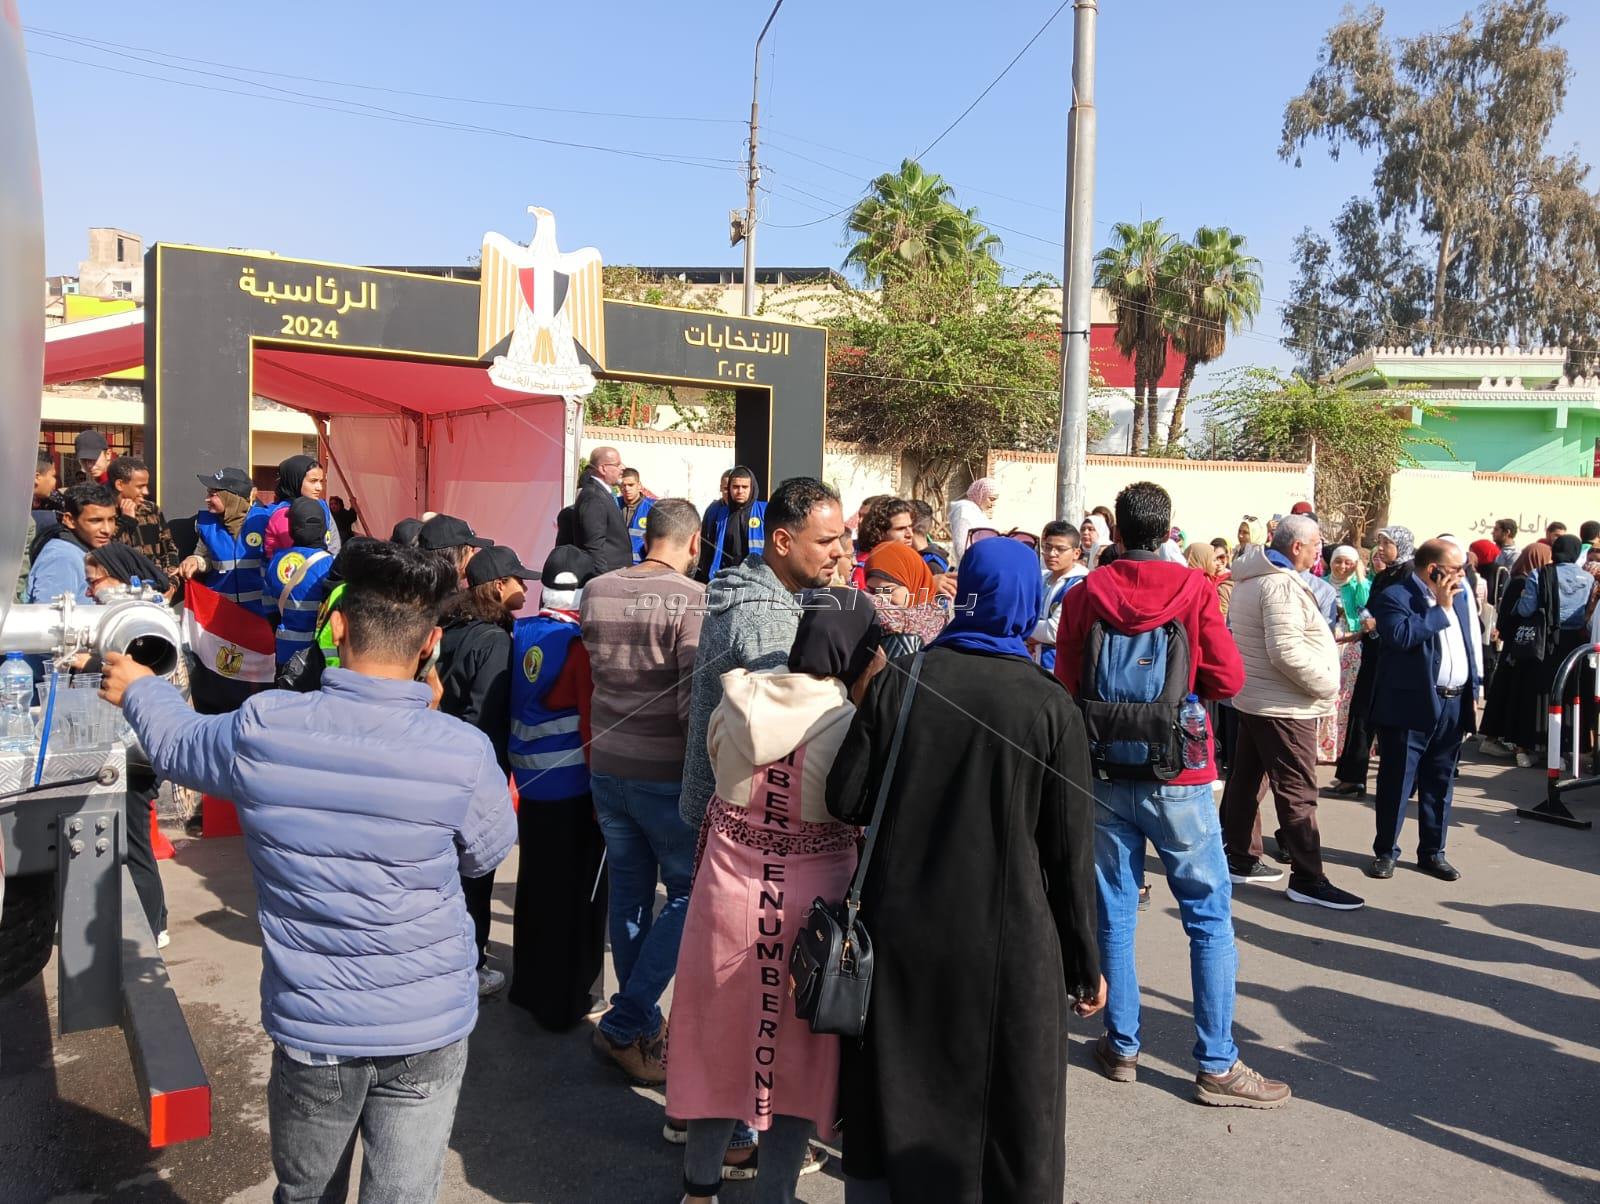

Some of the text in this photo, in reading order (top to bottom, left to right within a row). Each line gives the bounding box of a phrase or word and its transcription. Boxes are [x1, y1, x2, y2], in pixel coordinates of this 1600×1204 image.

[239, 266, 377, 314] الرئاسية
[280, 314, 339, 339] 2024
[684, 323, 790, 356] الانتخابات
[717, 359, 756, 380] ٢٠٢٤
